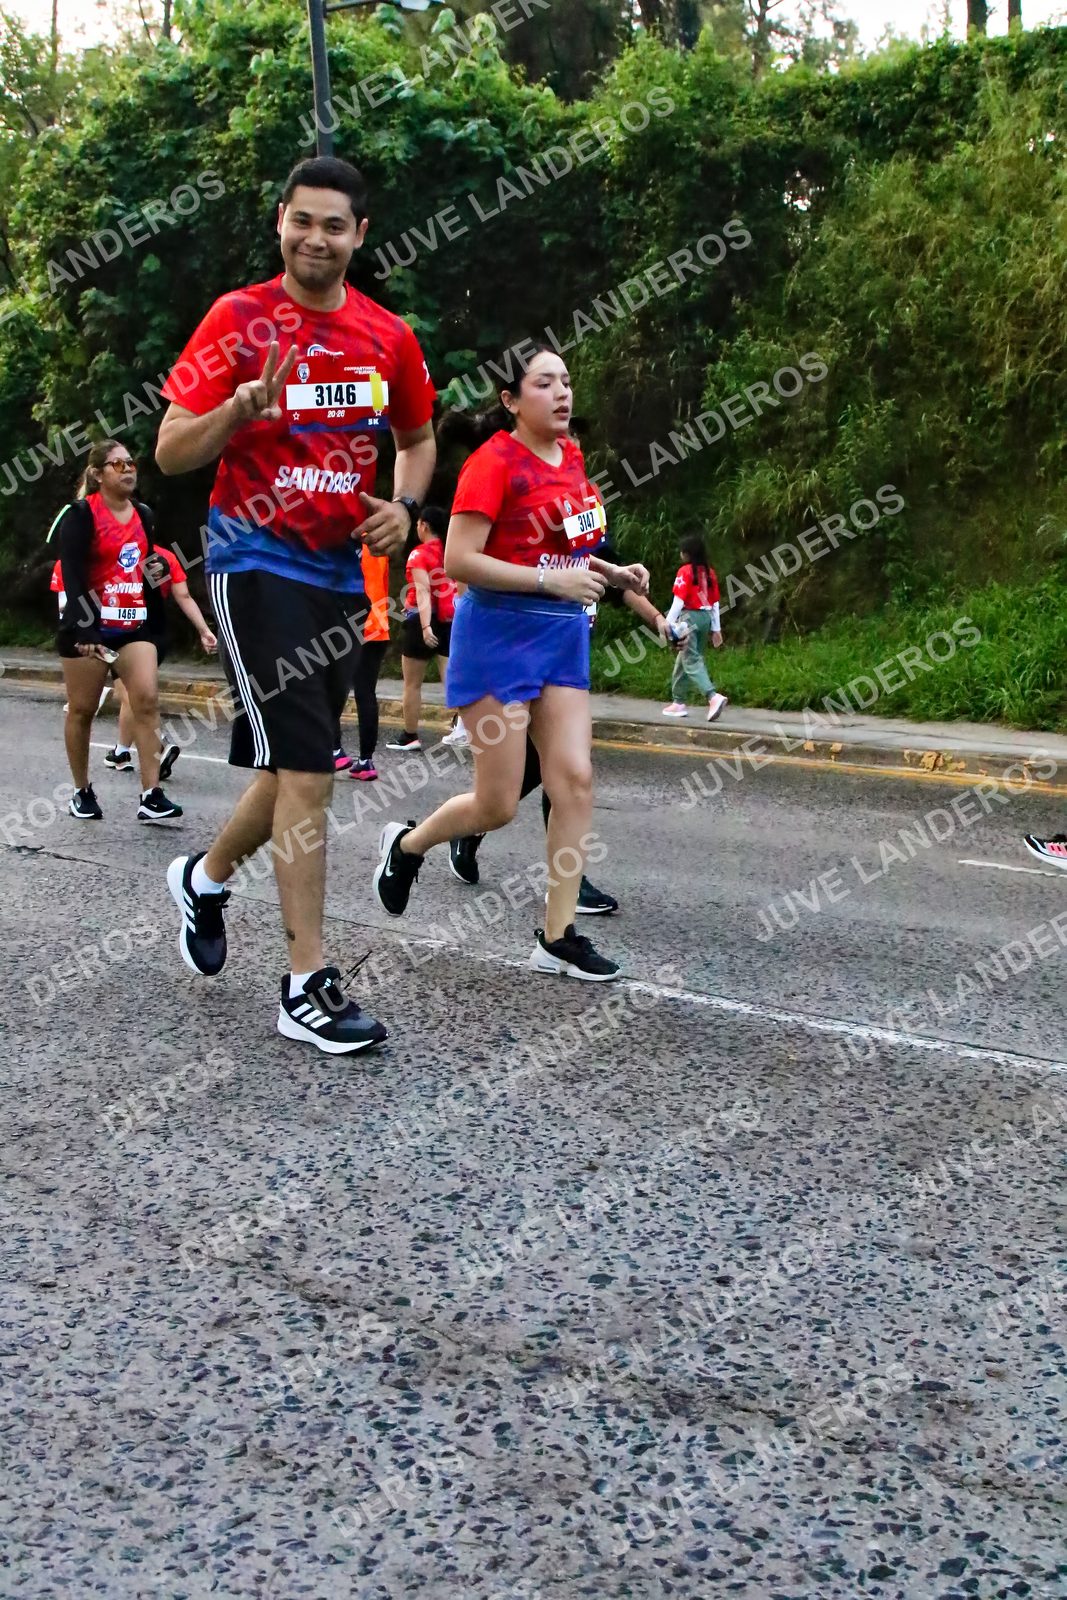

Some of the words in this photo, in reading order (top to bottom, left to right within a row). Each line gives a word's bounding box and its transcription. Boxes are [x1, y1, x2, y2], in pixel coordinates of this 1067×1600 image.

[315, 384, 356, 406] 3146
[578, 511, 595, 532] 3147
[118, 608, 136, 620] 1469
